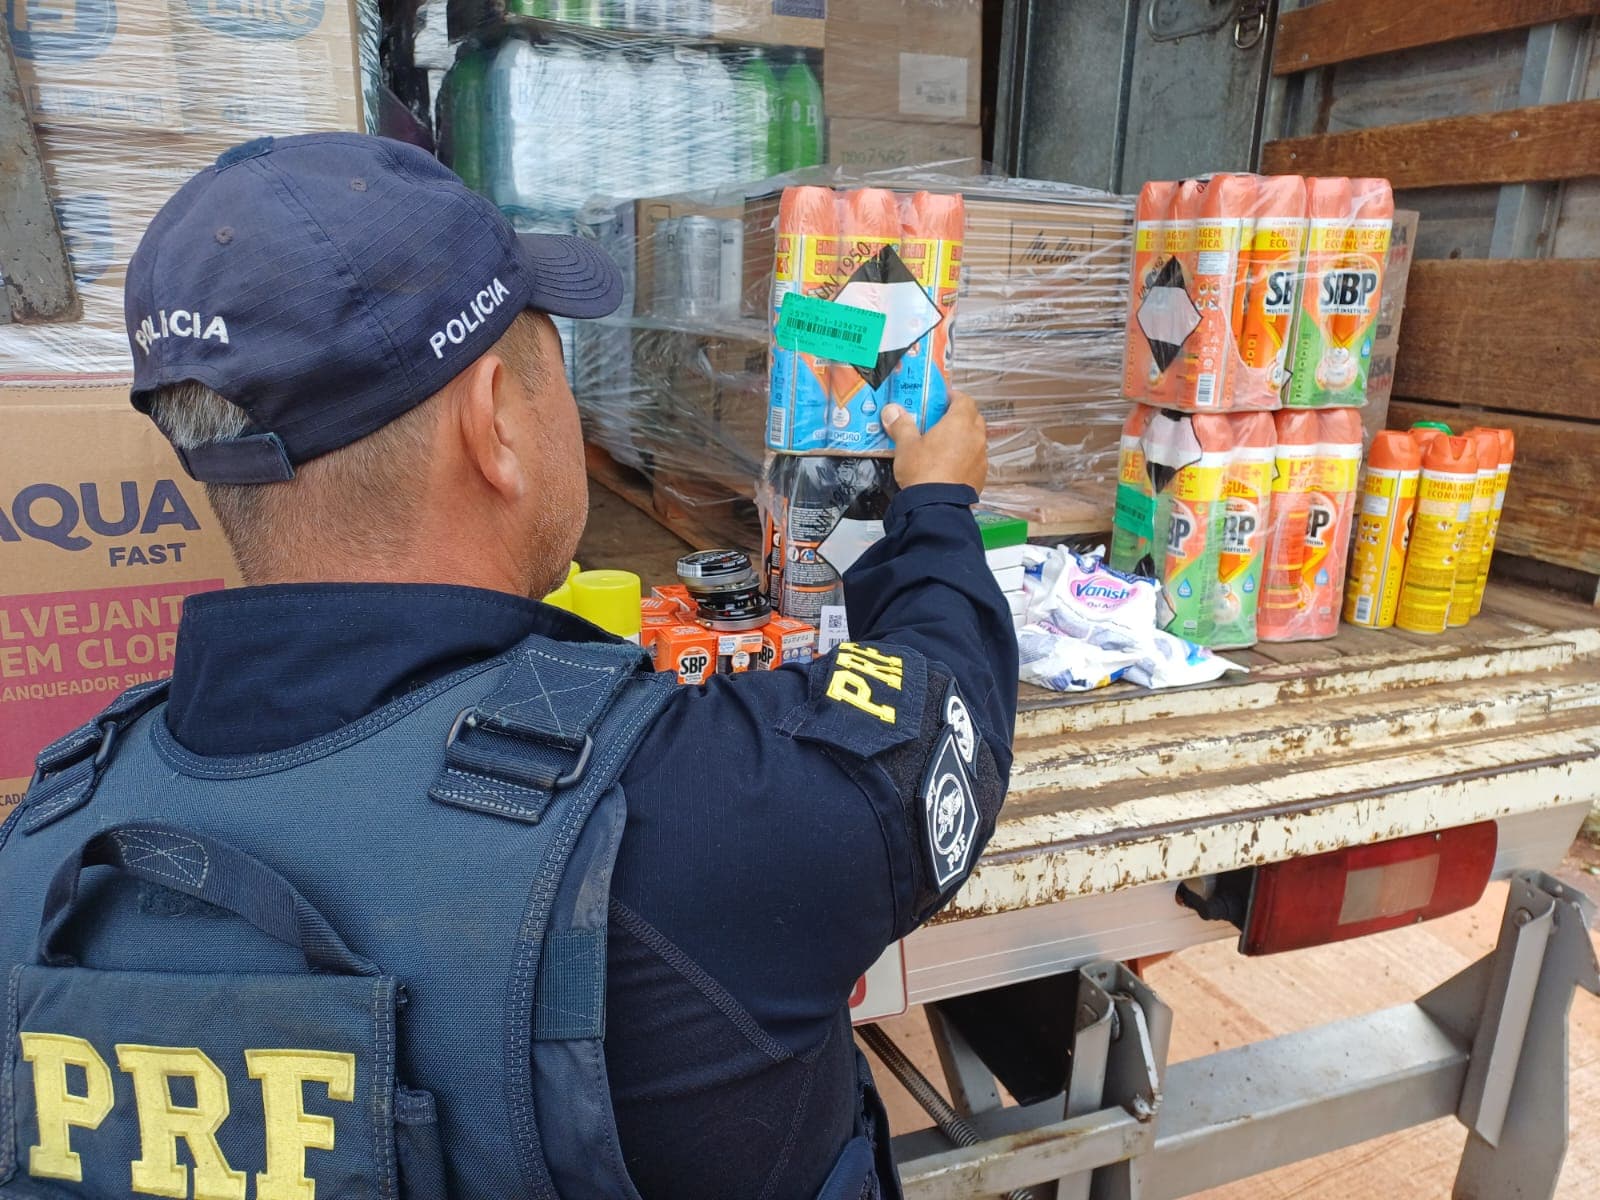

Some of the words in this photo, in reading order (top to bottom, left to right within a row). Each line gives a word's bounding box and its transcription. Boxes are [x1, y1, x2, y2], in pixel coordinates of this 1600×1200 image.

[109, 543, 187, 567] FAST
[1076, 577, 1131, 600] Vanish
[680, 656, 707, 676] SBP
[826, 642, 903, 724] PRF
[947, 834, 967, 872] PRF
[20, 1032, 355, 1200] PRF
